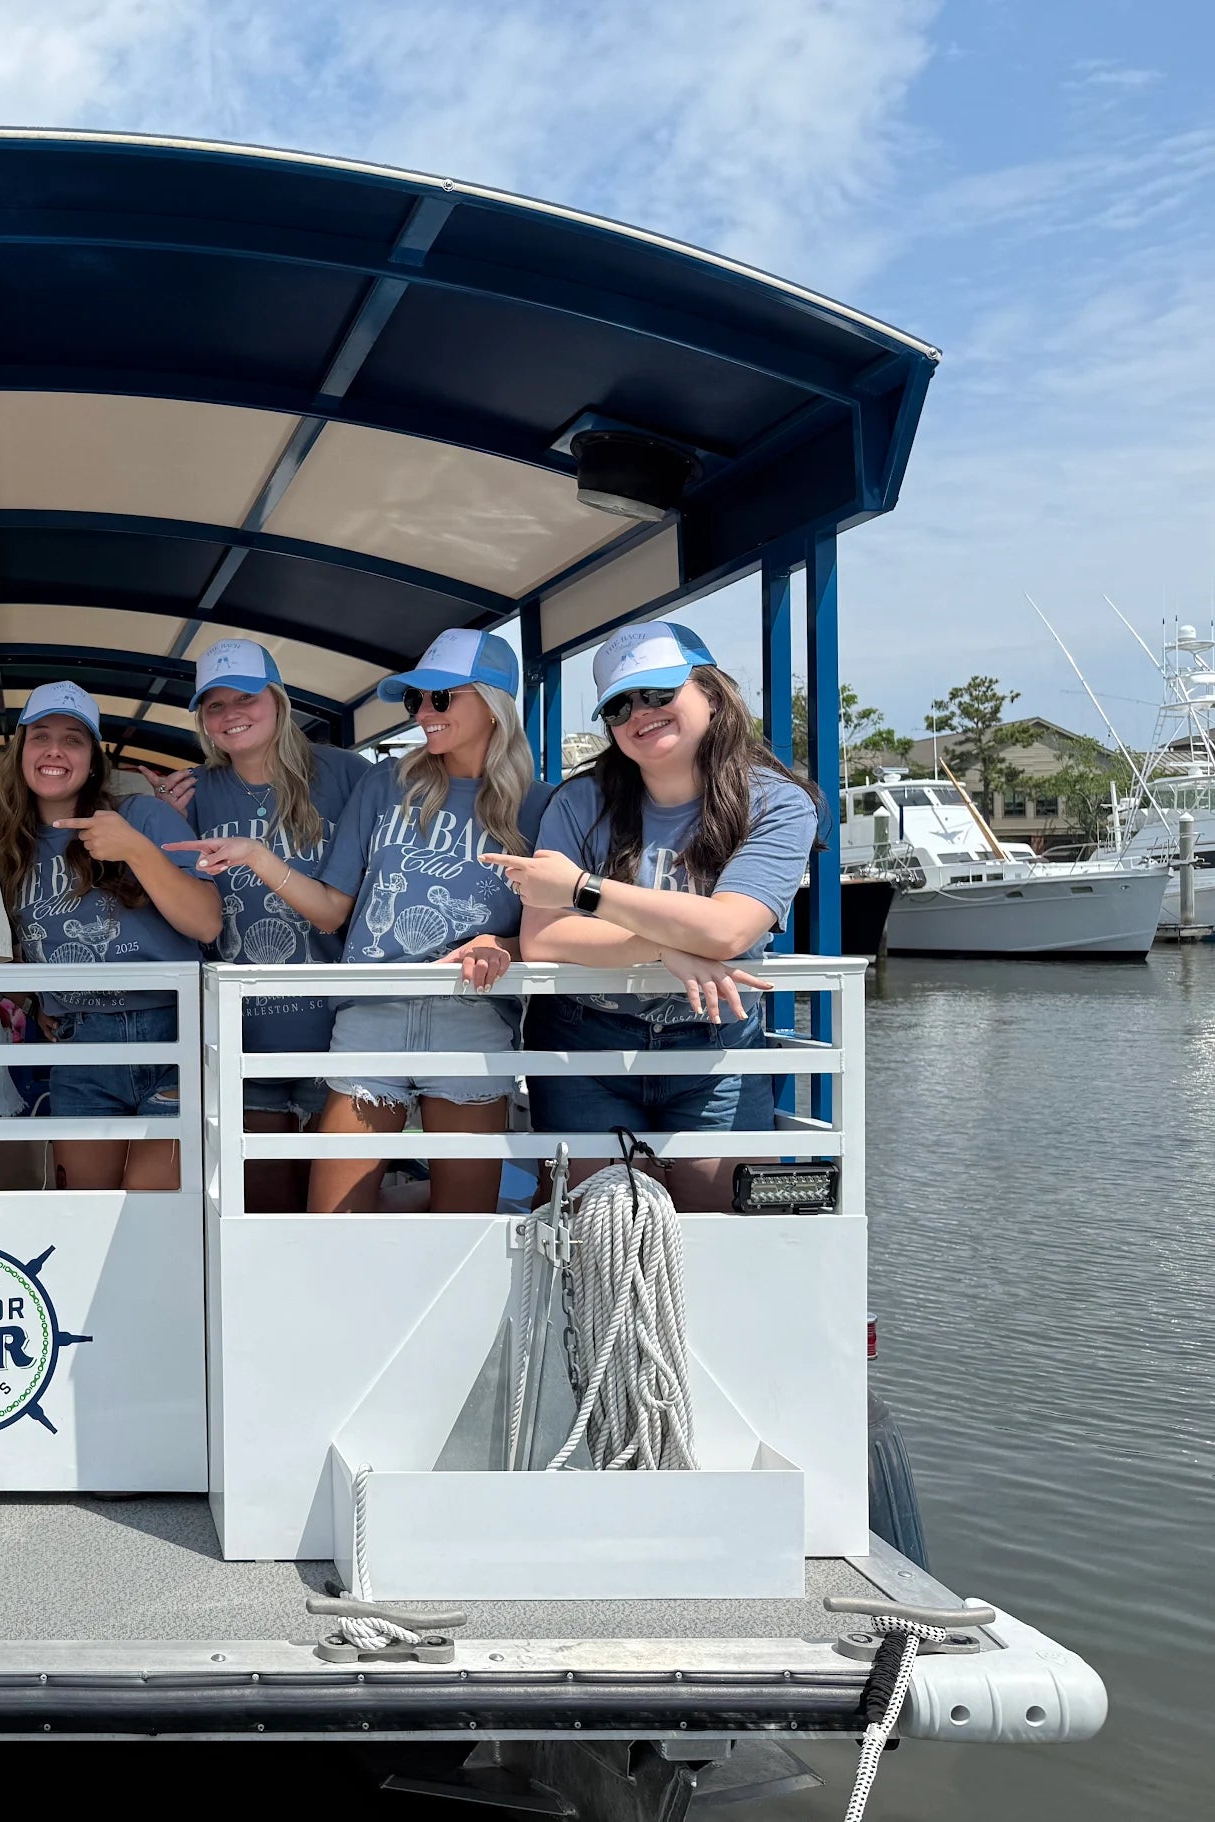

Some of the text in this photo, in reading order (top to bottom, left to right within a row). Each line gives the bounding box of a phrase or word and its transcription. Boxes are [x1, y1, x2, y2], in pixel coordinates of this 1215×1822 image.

[400, 846, 464, 880] Club
[115, 941, 140, 955] 2025
[242, 1003, 304, 1018] RLESTON,
[309, 999, 324, 1010] SC
